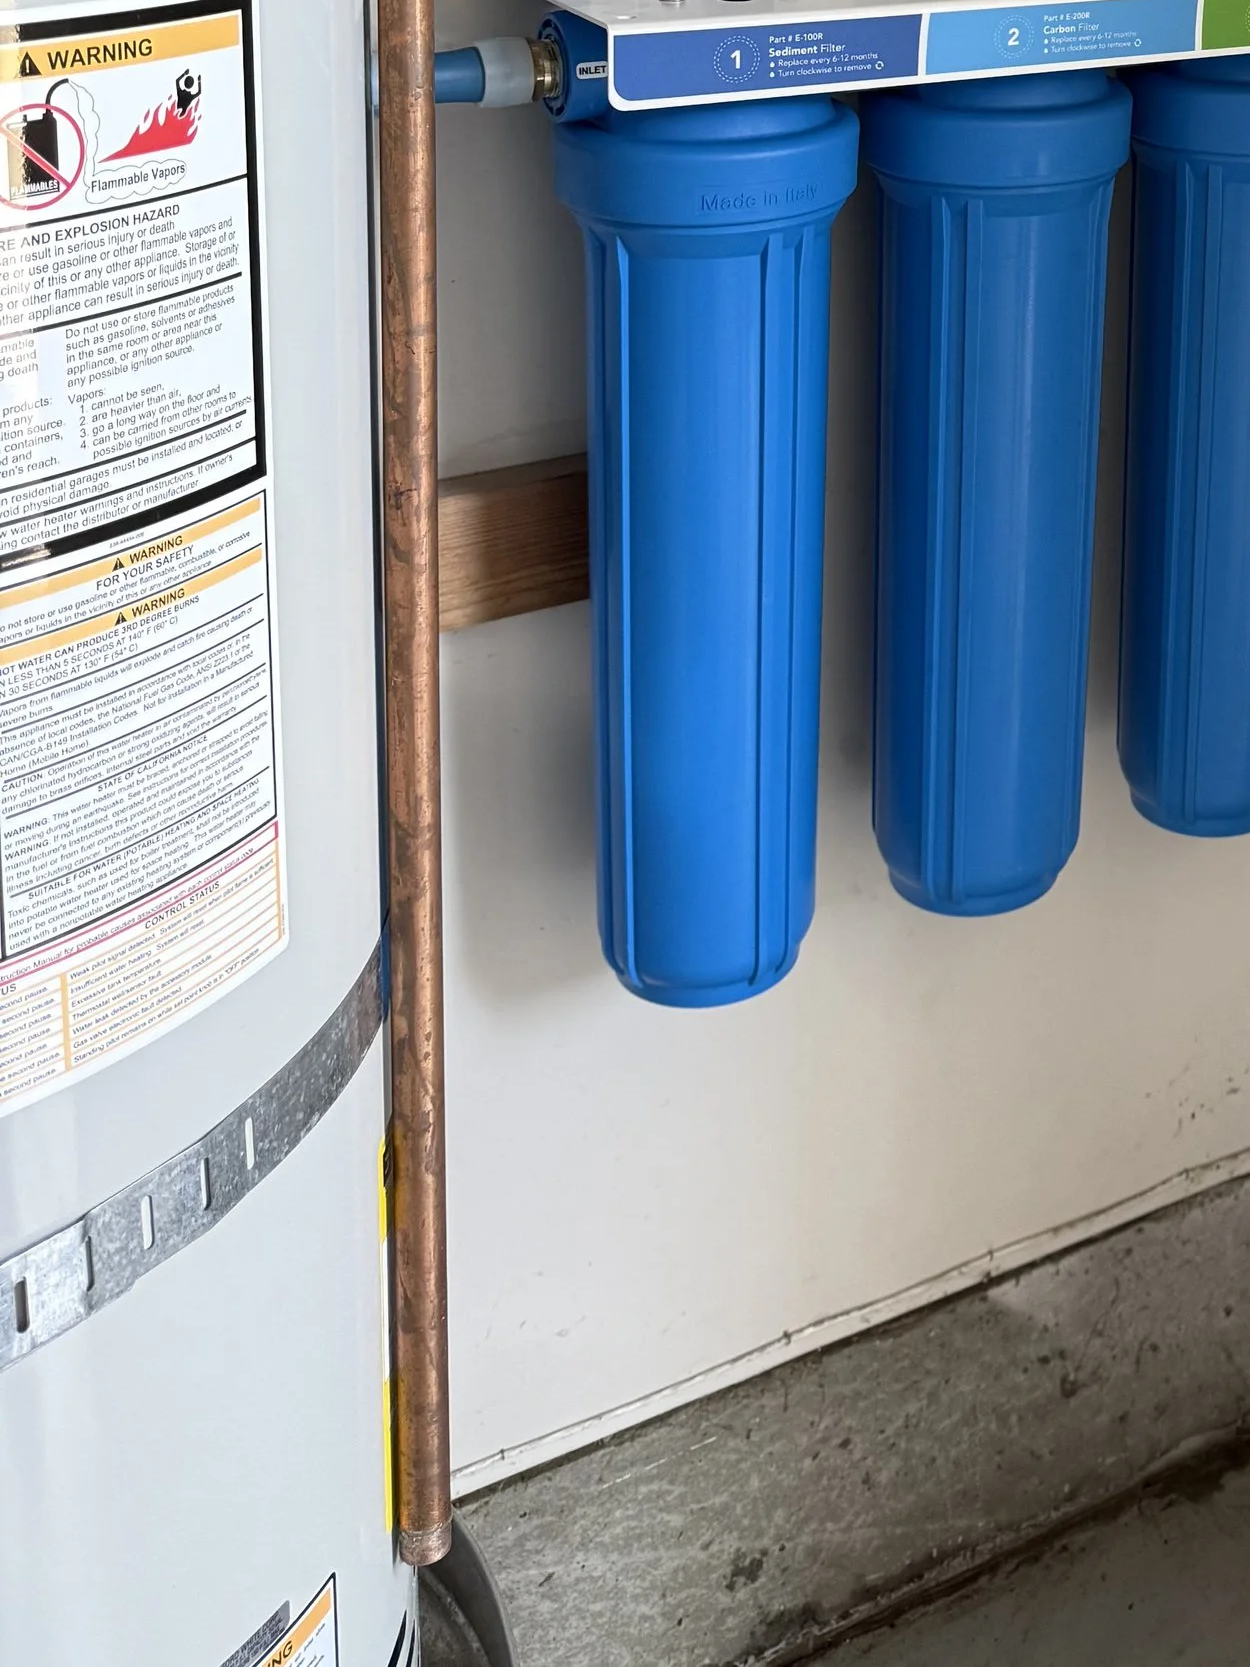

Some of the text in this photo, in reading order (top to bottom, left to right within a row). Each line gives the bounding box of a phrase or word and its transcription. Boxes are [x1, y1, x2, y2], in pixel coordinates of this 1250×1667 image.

[1043, 22, 1100, 35] Carbon Filter
[1044, 14, 1058, 22] Part
[1066, 11, 1091, 21] E-200R
[769, 35, 786, 44] Part
[795, 33, 824, 42] E-100R
[769, 43, 846, 57] Sediment Filter
[1007, 27, 1020, 46] 2
[1051, 35, 1077, 45] Replace
[1078, 34, 1097, 43] every
[1051, 45, 1066, 54] Turn
[1066, 43, 1098, 52] clockwise
[1107, 41, 1131, 49] remove
[47, 38, 153, 70] WARNING
[730, 49, 741, 69] 1
[778, 52, 878, 68] Replace every 6-12 months
[579, 65, 607, 76] INLET
[778, 69, 795, 77] Turn
[797, 66, 832, 76] clockwise
[843, 63, 872, 72] remove
[91, 164, 186, 193] Flammable Vapors
[700, 183, 817, 210] Made in Italy
[20, 233, 51, 249] AND
[55, 216, 130, 242] EXPLOSION
[133, 204, 180, 226] HAZARD
[20, 246, 52, 263] result
[67, 237, 106, 254] serious
[137, 229, 148, 239] or
[149, 220, 175, 236] death
[29, 264, 49, 276] use
[52, 254, 98, 274] gasoline
[100, 250, 110, 261] or
[113, 243, 139, 258] other
[141, 230, 187, 252] flammable
[189, 224, 217, 239] vapors
[218, 216, 233, 231] and
[34, 277, 46, 290] of
[48, 274, 68, 287] this
[70, 270, 82, 282] or
[84, 266, 104, 279] any
[106, 259, 132, 274] other
[134, 248, 181, 269] appliance.
[185, 237, 217, 254] Storage
[219, 231, 228, 244] of
[7, 299, 18, 310] or
[22, 293, 52, 308] other
[54, 279, 110, 301] flammable
[112, 271, 145, 288] vapors
[147, 267, 157, 278] or
[159, 259, 188, 276] liquids
[199, 251, 213, 264] the
[213, 243, 240, 259] vicinity
[28, 304, 82, 323] appliance
[84, 296, 104, 309] can
[106, 286, 134, 303] result
[147, 276, 180, 294] serious
[206, 264, 216, 275] or
[65, 285, 234, 340] Do not use or store flammable products
[129, 535, 183, 565] WARNING
[96, 545, 194, 591] FOR YOUR SAFETY
[131, 588, 186, 618] WARNING
[18, 595, 200, 671] WATER CAN PRODUCE 3RD DEGREE BURNS
[8, 672, 33, 685] LESS
[36, 662, 61, 677] THAN
[63, 658, 69, 667] 5
[71, 642, 114, 664] SECONDS
[115, 637, 126, 646] AT
[146, 627, 152, 635] F
[97, 735, 208, 793] STATE OF CALIFORNIA NOTICE
[28, 836, 164, 900] SUITABLE FOR WATER (POTABLE)
[144, 880, 220, 930] CONTROL STATUS
